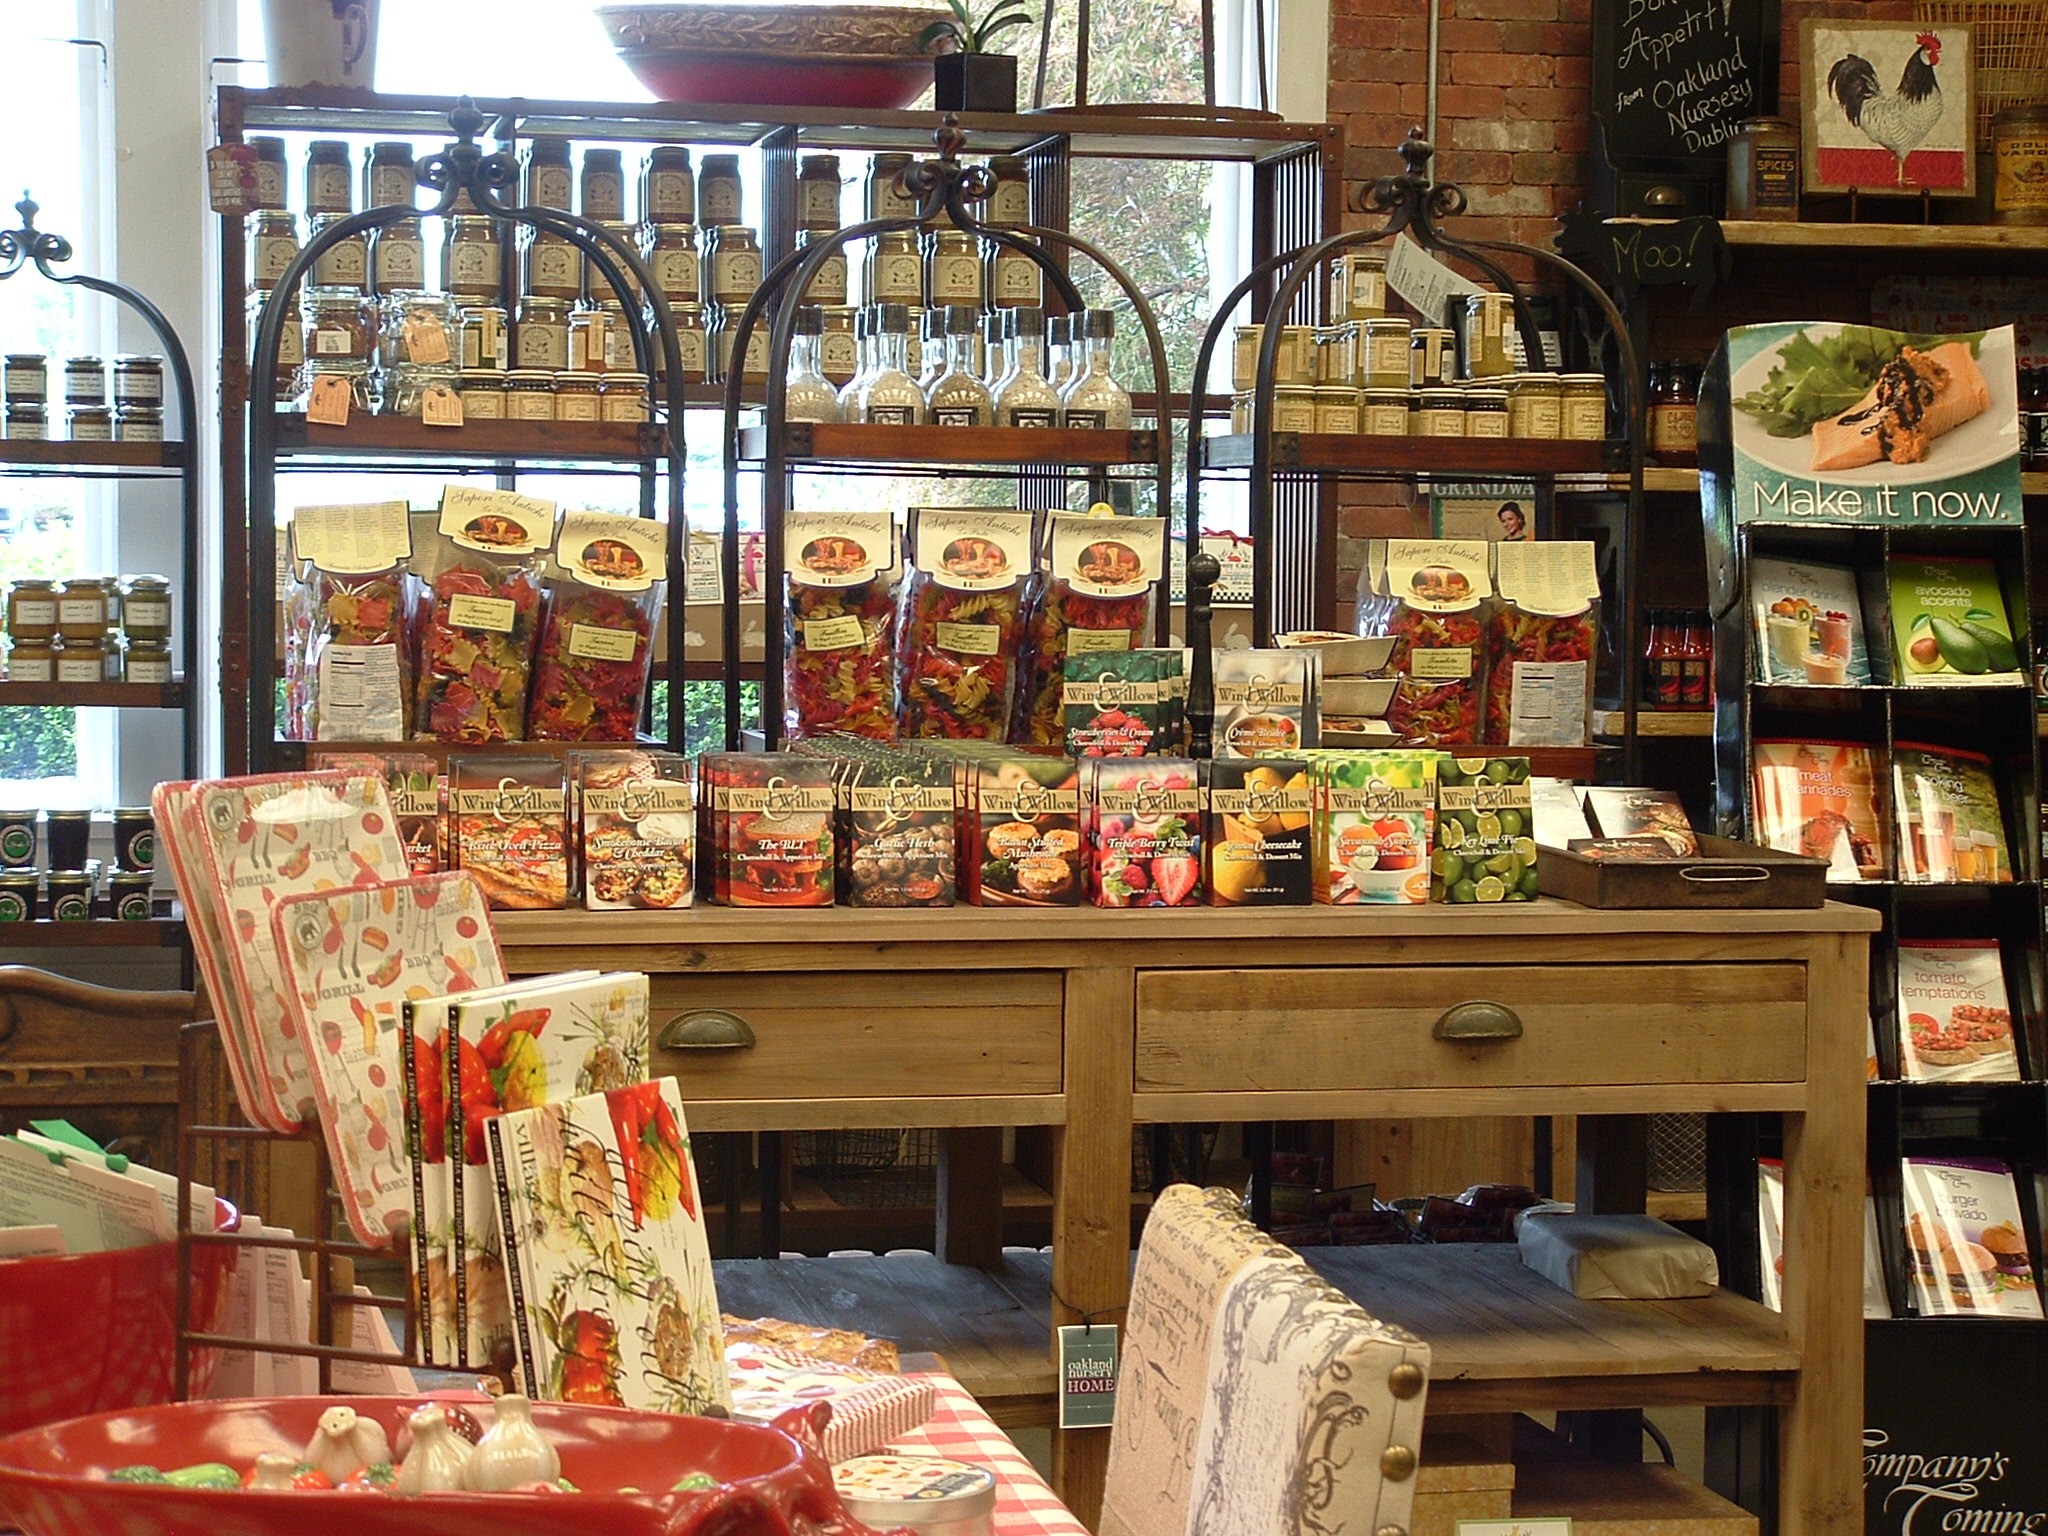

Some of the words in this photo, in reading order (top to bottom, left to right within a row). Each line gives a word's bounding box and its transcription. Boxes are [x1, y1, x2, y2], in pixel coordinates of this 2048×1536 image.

[1653, 36, 1747, 109] Oakland
[1756, 160, 1795, 172] SPICES
[1613, 224, 1703, 279] Moo!
[1752, 480, 1863, 518] Make
[1875, 483, 1900, 518] it
[1912, 490, 2008, 520] now.
[1915, 585, 1972, 597] avocado
[1920, 596, 1973, 608] accents
[1067, 686, 1099, 702] Wind
[1108, 683, 1158, 702] Willow
[1218, 687, 1250, 703] Wind
[1257, 686, 1302, 704] Willow
[1799, 771, 1833, 782] meat
[462, 794, 503, 811] Wind
[510, 794, 562, 811] Willow
[587, 793, 628, 810] Wind
[634, 791, 687, 810] Willow
[732, 792, 772, 809] Wind
[779, 790, 832, 809] Willow
[855, 793, 893, 808] Wind
[901, 792, 952, 808] Willow
[982, 794, 1022, 810] Wind
[1029, 794, 1077, 810] Willow
[1102, 795, 1141, 811] Wind
[1147, 793, 1197, 811] Willow
[1215, 794, 1251, 810] Wind
[1260, 792, 1309, 810] Willow
[1332, 793, 1371, 808] Wind
[1375, 791, 1423, 808] Willow
[1443, 792, 1480, 807] Wind
[1485, 790, 1531, 806] Willow
[529, 840, 562, 850] Pizza
[758, 839, 779, 850] The
[908, 838, 935, 848] Herb
[1107, 838, 1138, 849] Triple
[1138, 838, 1167, 850] Berry
[1254, 839, 1303, 852] Cheesecake
[235, 874, 277, 888] GRILL
[404, 955, 432, 968] BBQ
[1914, 971, 1967, 985] tomato
[321, 983, 366, 1000] GRILL
[555, 1117, 608, 1230] huile
[590, 1148, 668, 1303] dipping
[634, 1325, 699, 1400] oil
[1067, 1357, 1114, 1372] oakland
[1068, 1369, 1113, 1378] nursery
[1067, 1379, 1115, 1393] HOME
